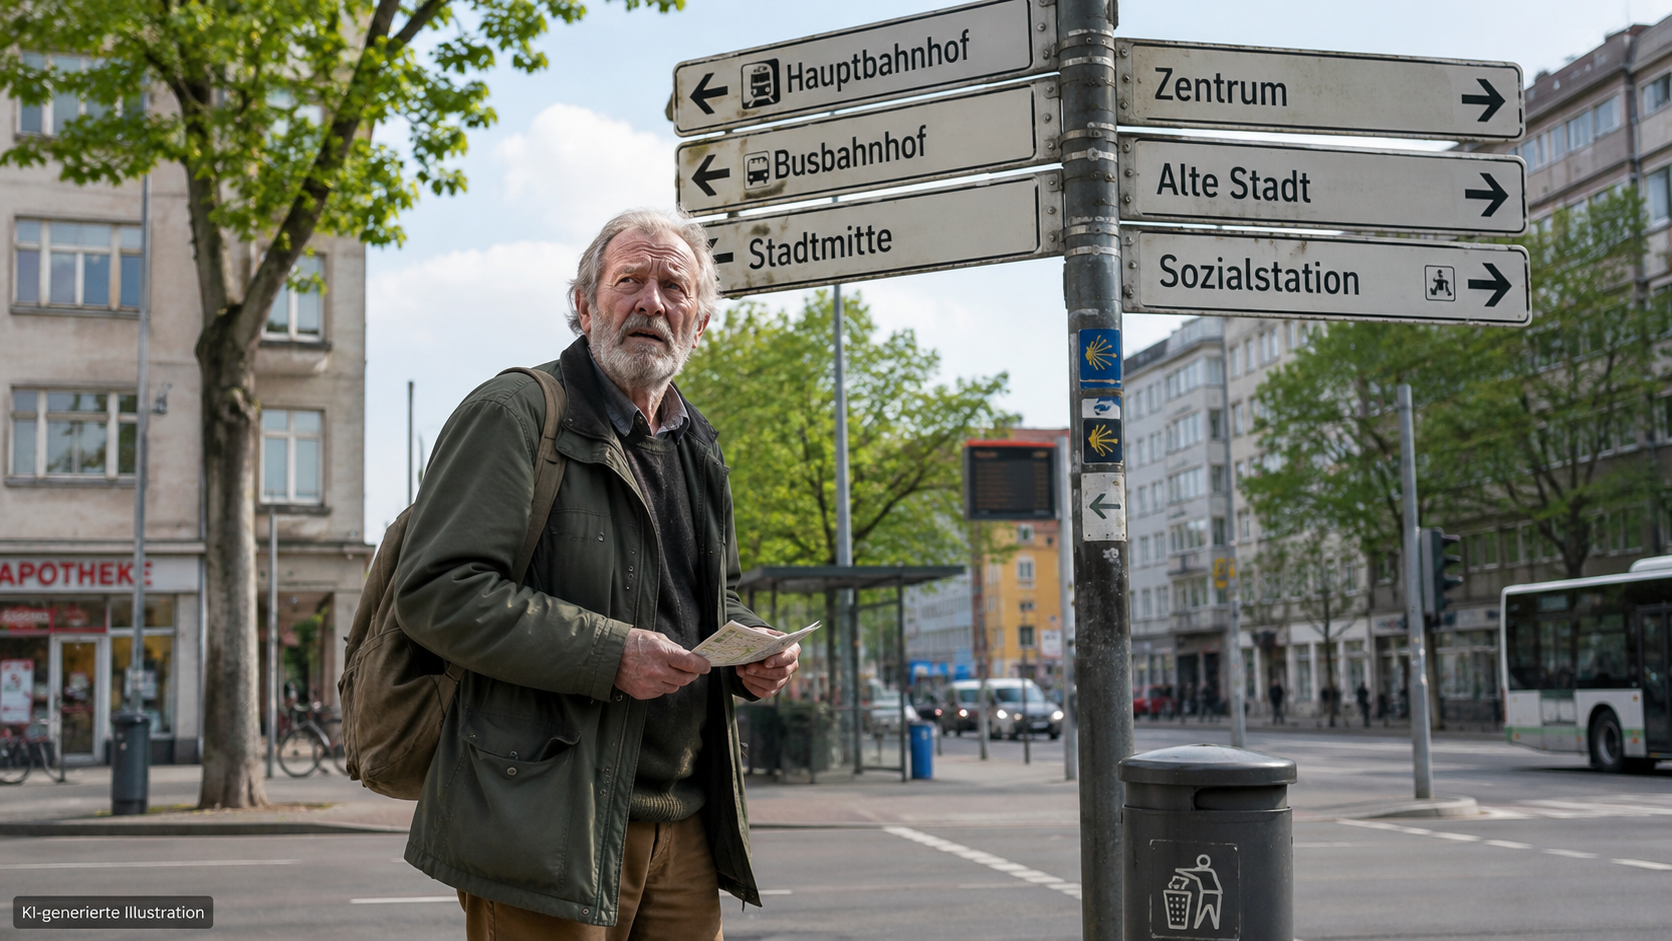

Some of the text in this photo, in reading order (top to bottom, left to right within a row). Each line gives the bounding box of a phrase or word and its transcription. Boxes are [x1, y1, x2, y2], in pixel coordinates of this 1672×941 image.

[786, 28, 970, 94] Hauptbahnhof
[1155, 67, 1287, 106] Zentrum
[774, 124, 927, 180] Busbahnhof
[1157, 162, 1312, 203] Alte Stadt
[749, 225, 893, 270] Stadtmitte
[1160, 254, 1360, 295] Sozialstation
[0, 561, 153, 586] APOTHEKE
